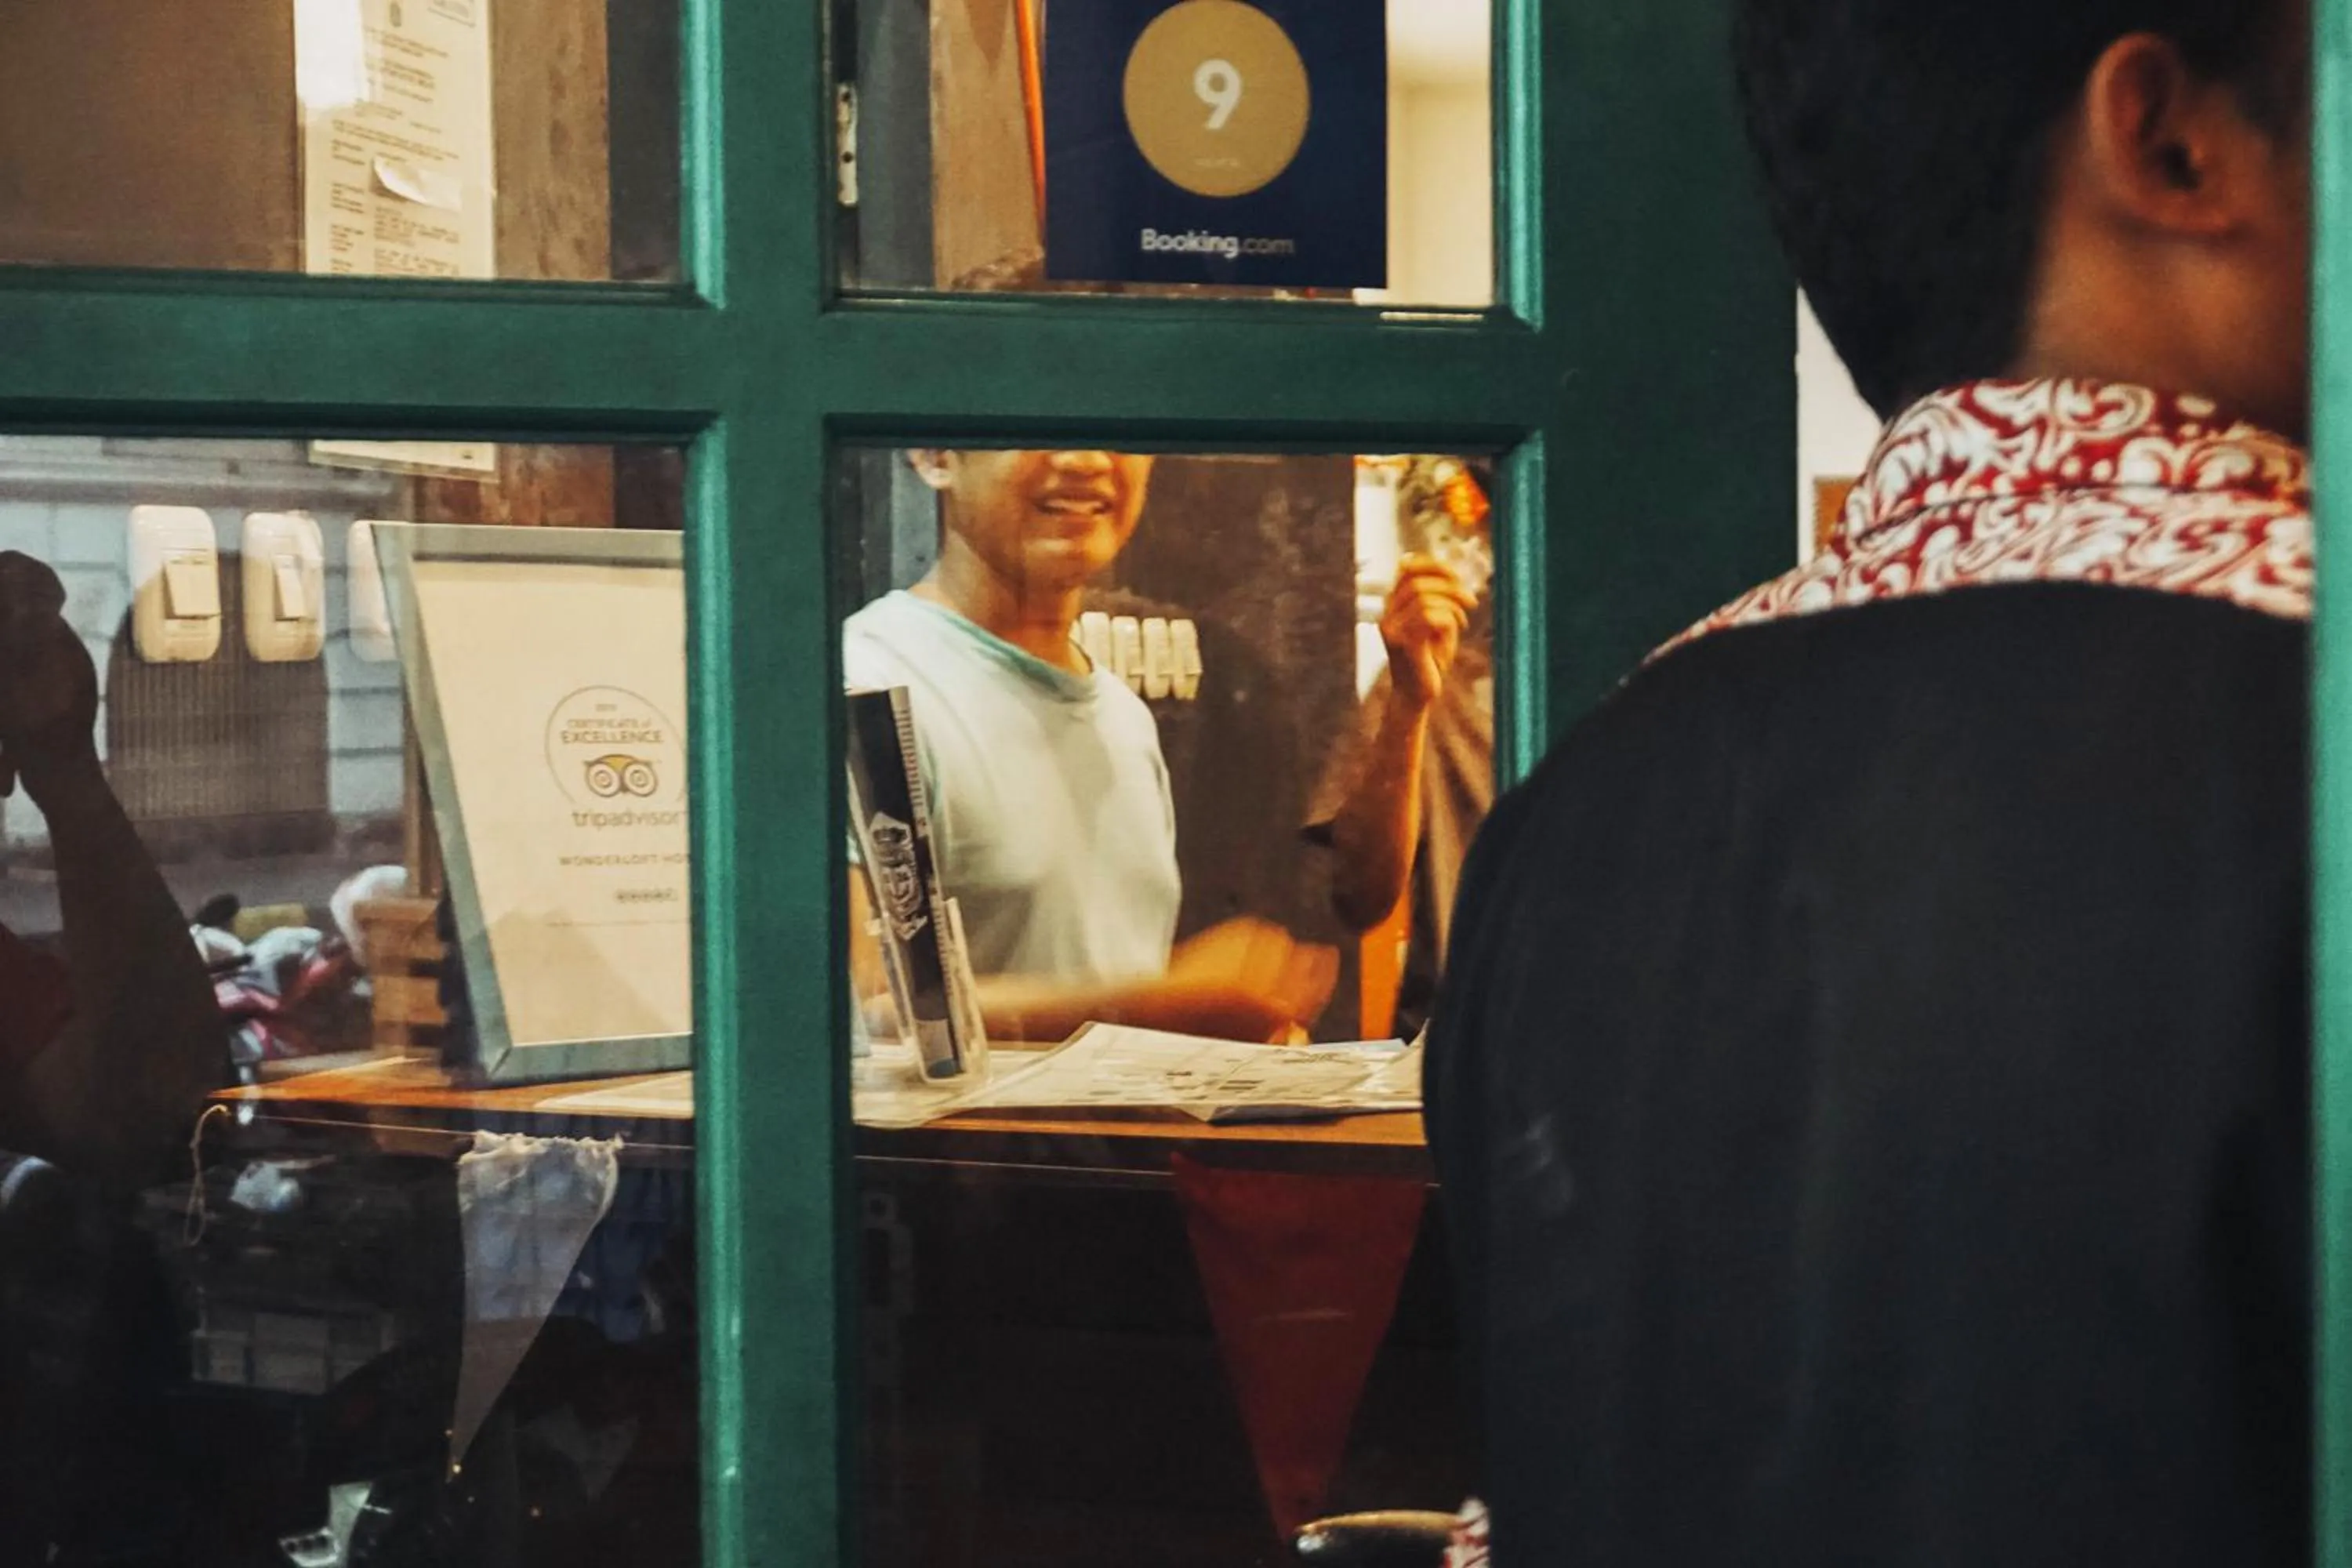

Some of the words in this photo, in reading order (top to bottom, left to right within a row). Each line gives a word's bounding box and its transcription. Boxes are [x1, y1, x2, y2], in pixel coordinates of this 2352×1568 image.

[1194, 58, 1242, 130] 9
[1142, 228, 1294, 259] Booking.com
[561, 730, 663, 744] EXCELLENCE
[572, 809, 679, 831] tripadvisor
